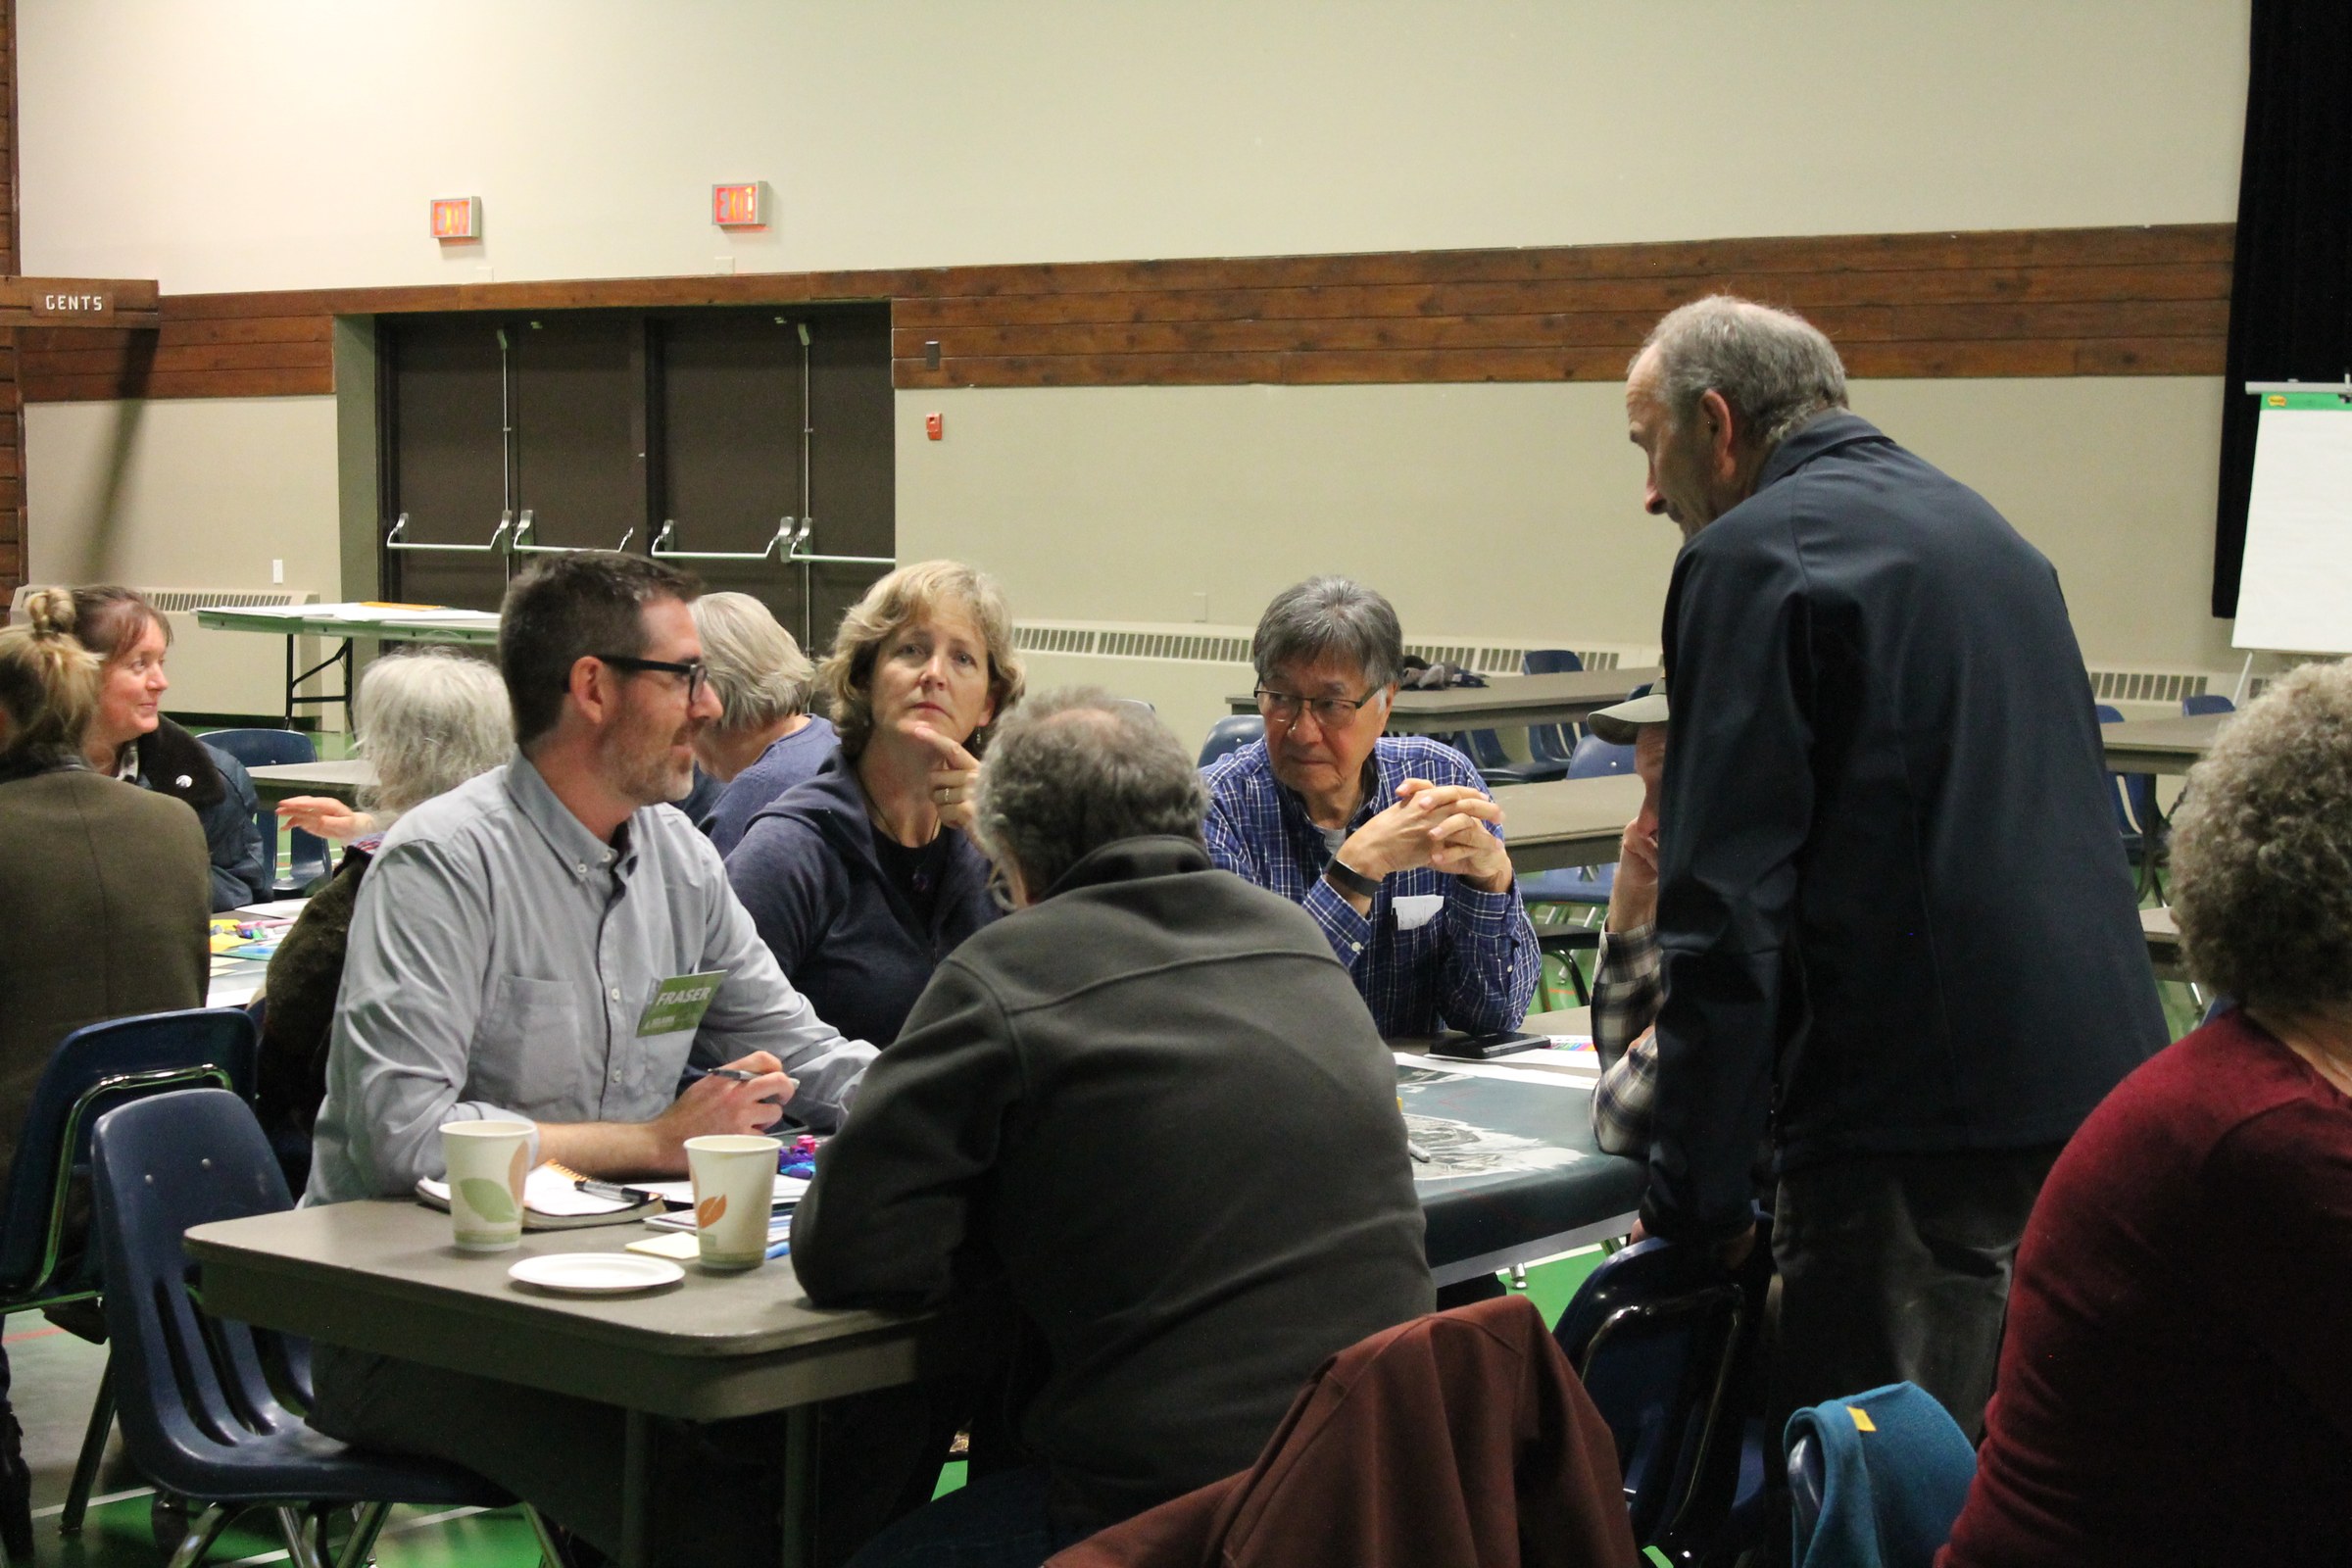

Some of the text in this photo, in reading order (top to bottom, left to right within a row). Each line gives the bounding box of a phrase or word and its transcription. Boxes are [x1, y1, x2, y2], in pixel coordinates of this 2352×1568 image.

[714, 186, 756, 222] EXIT
[45, 294, 103, 312] GENTS
[656, 987, 711, 1006] FRASER
